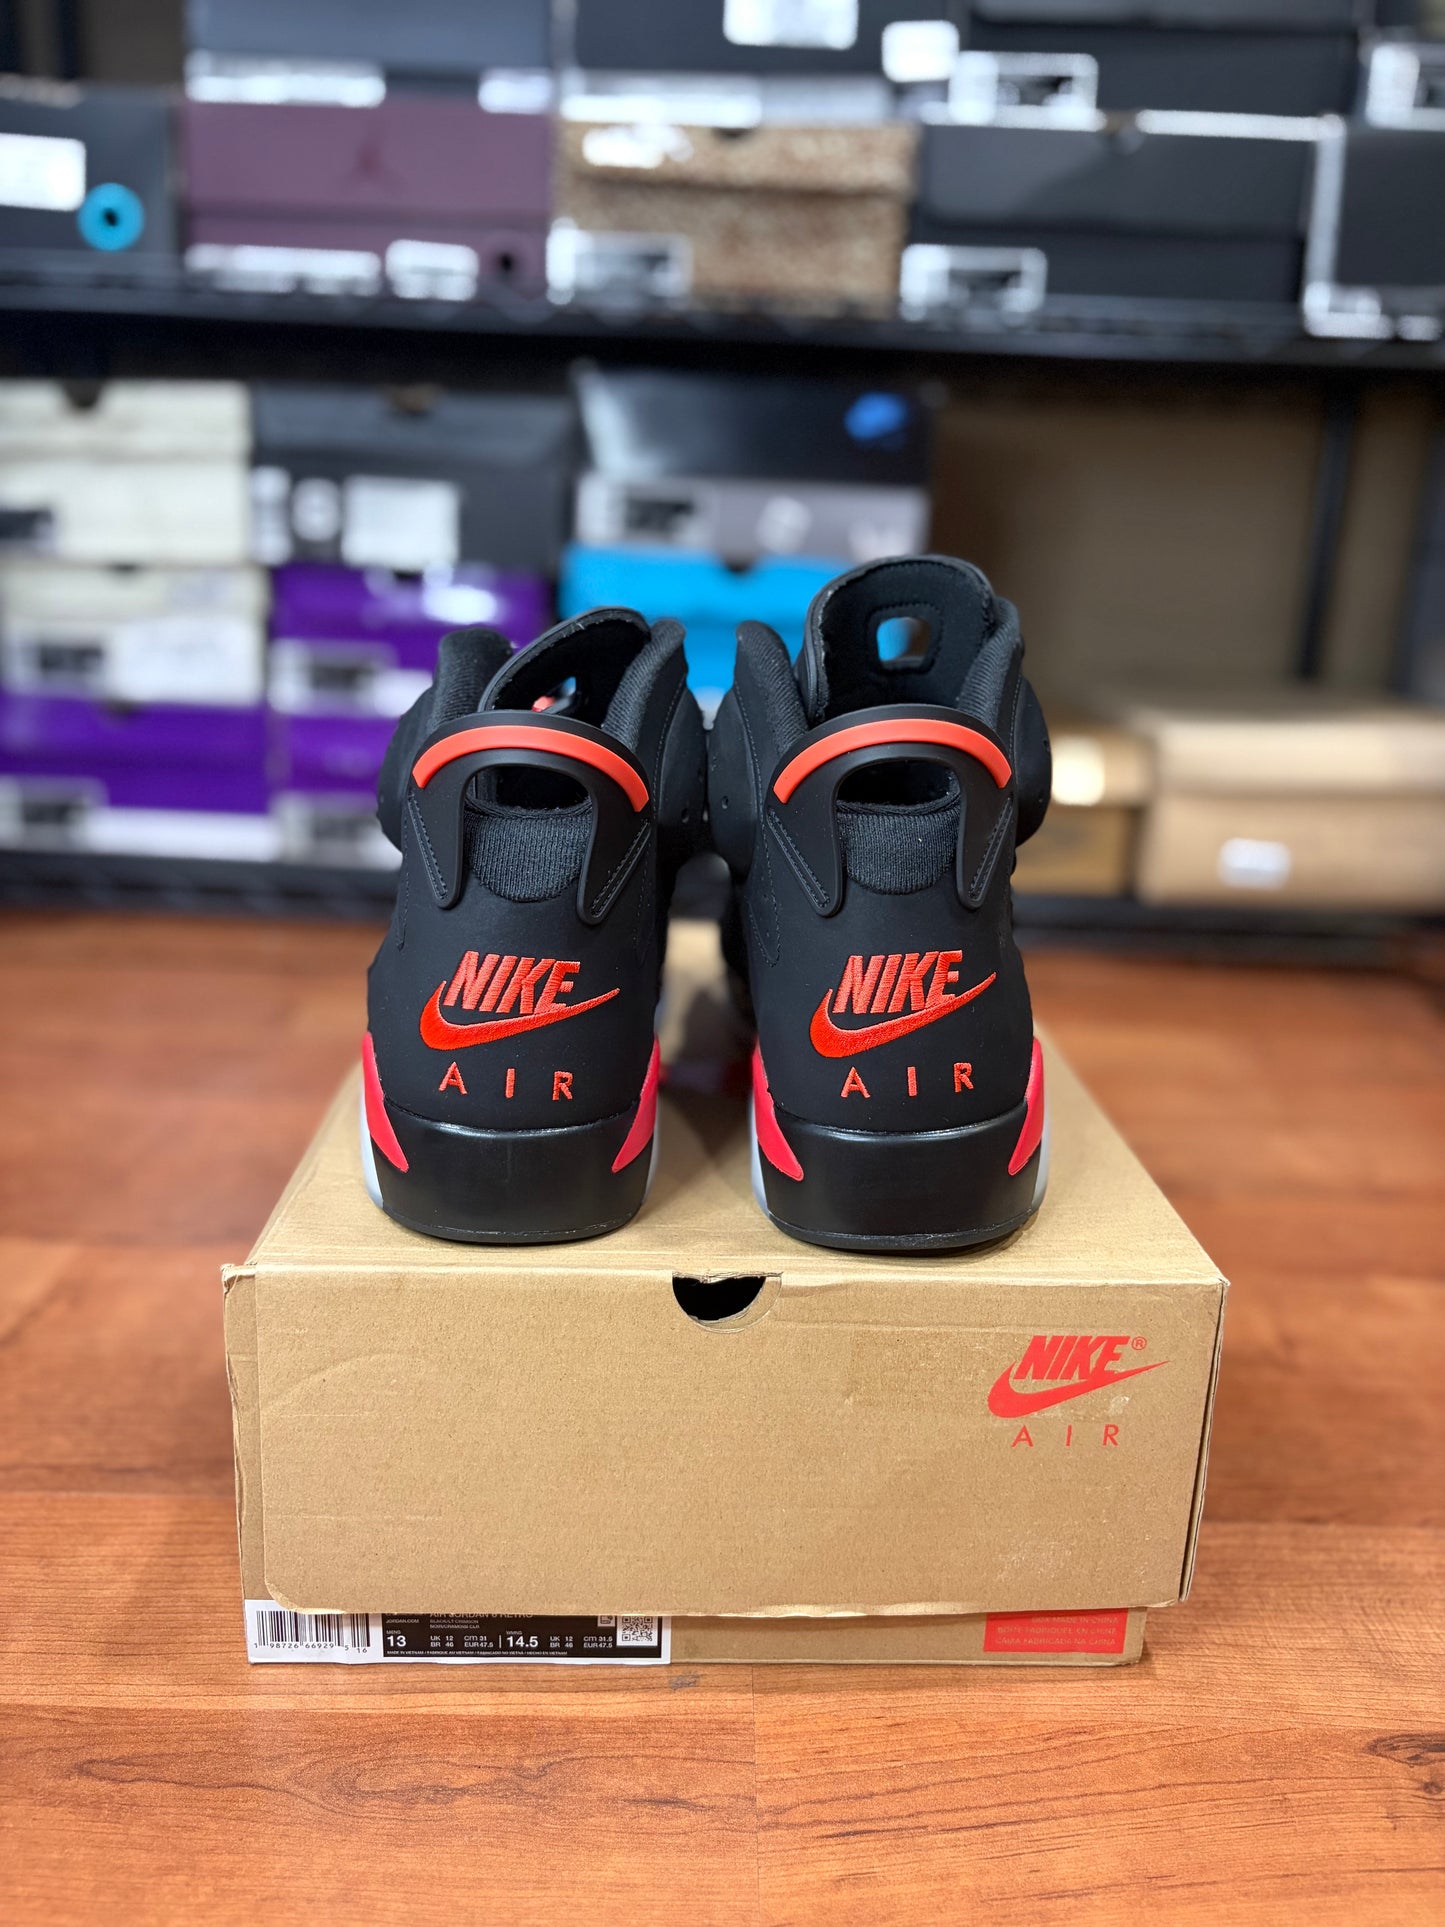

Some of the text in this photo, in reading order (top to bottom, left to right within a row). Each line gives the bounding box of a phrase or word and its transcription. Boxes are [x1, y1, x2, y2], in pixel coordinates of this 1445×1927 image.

[443, 950, 580, 1014] NIKE
[834, 949, 963, 1014] NIKE
[1011, 1423, 1120, 1448] AIR
[387, 1635, 407, 1648] 13
[506, 1636, 539, 1648] 14.5
